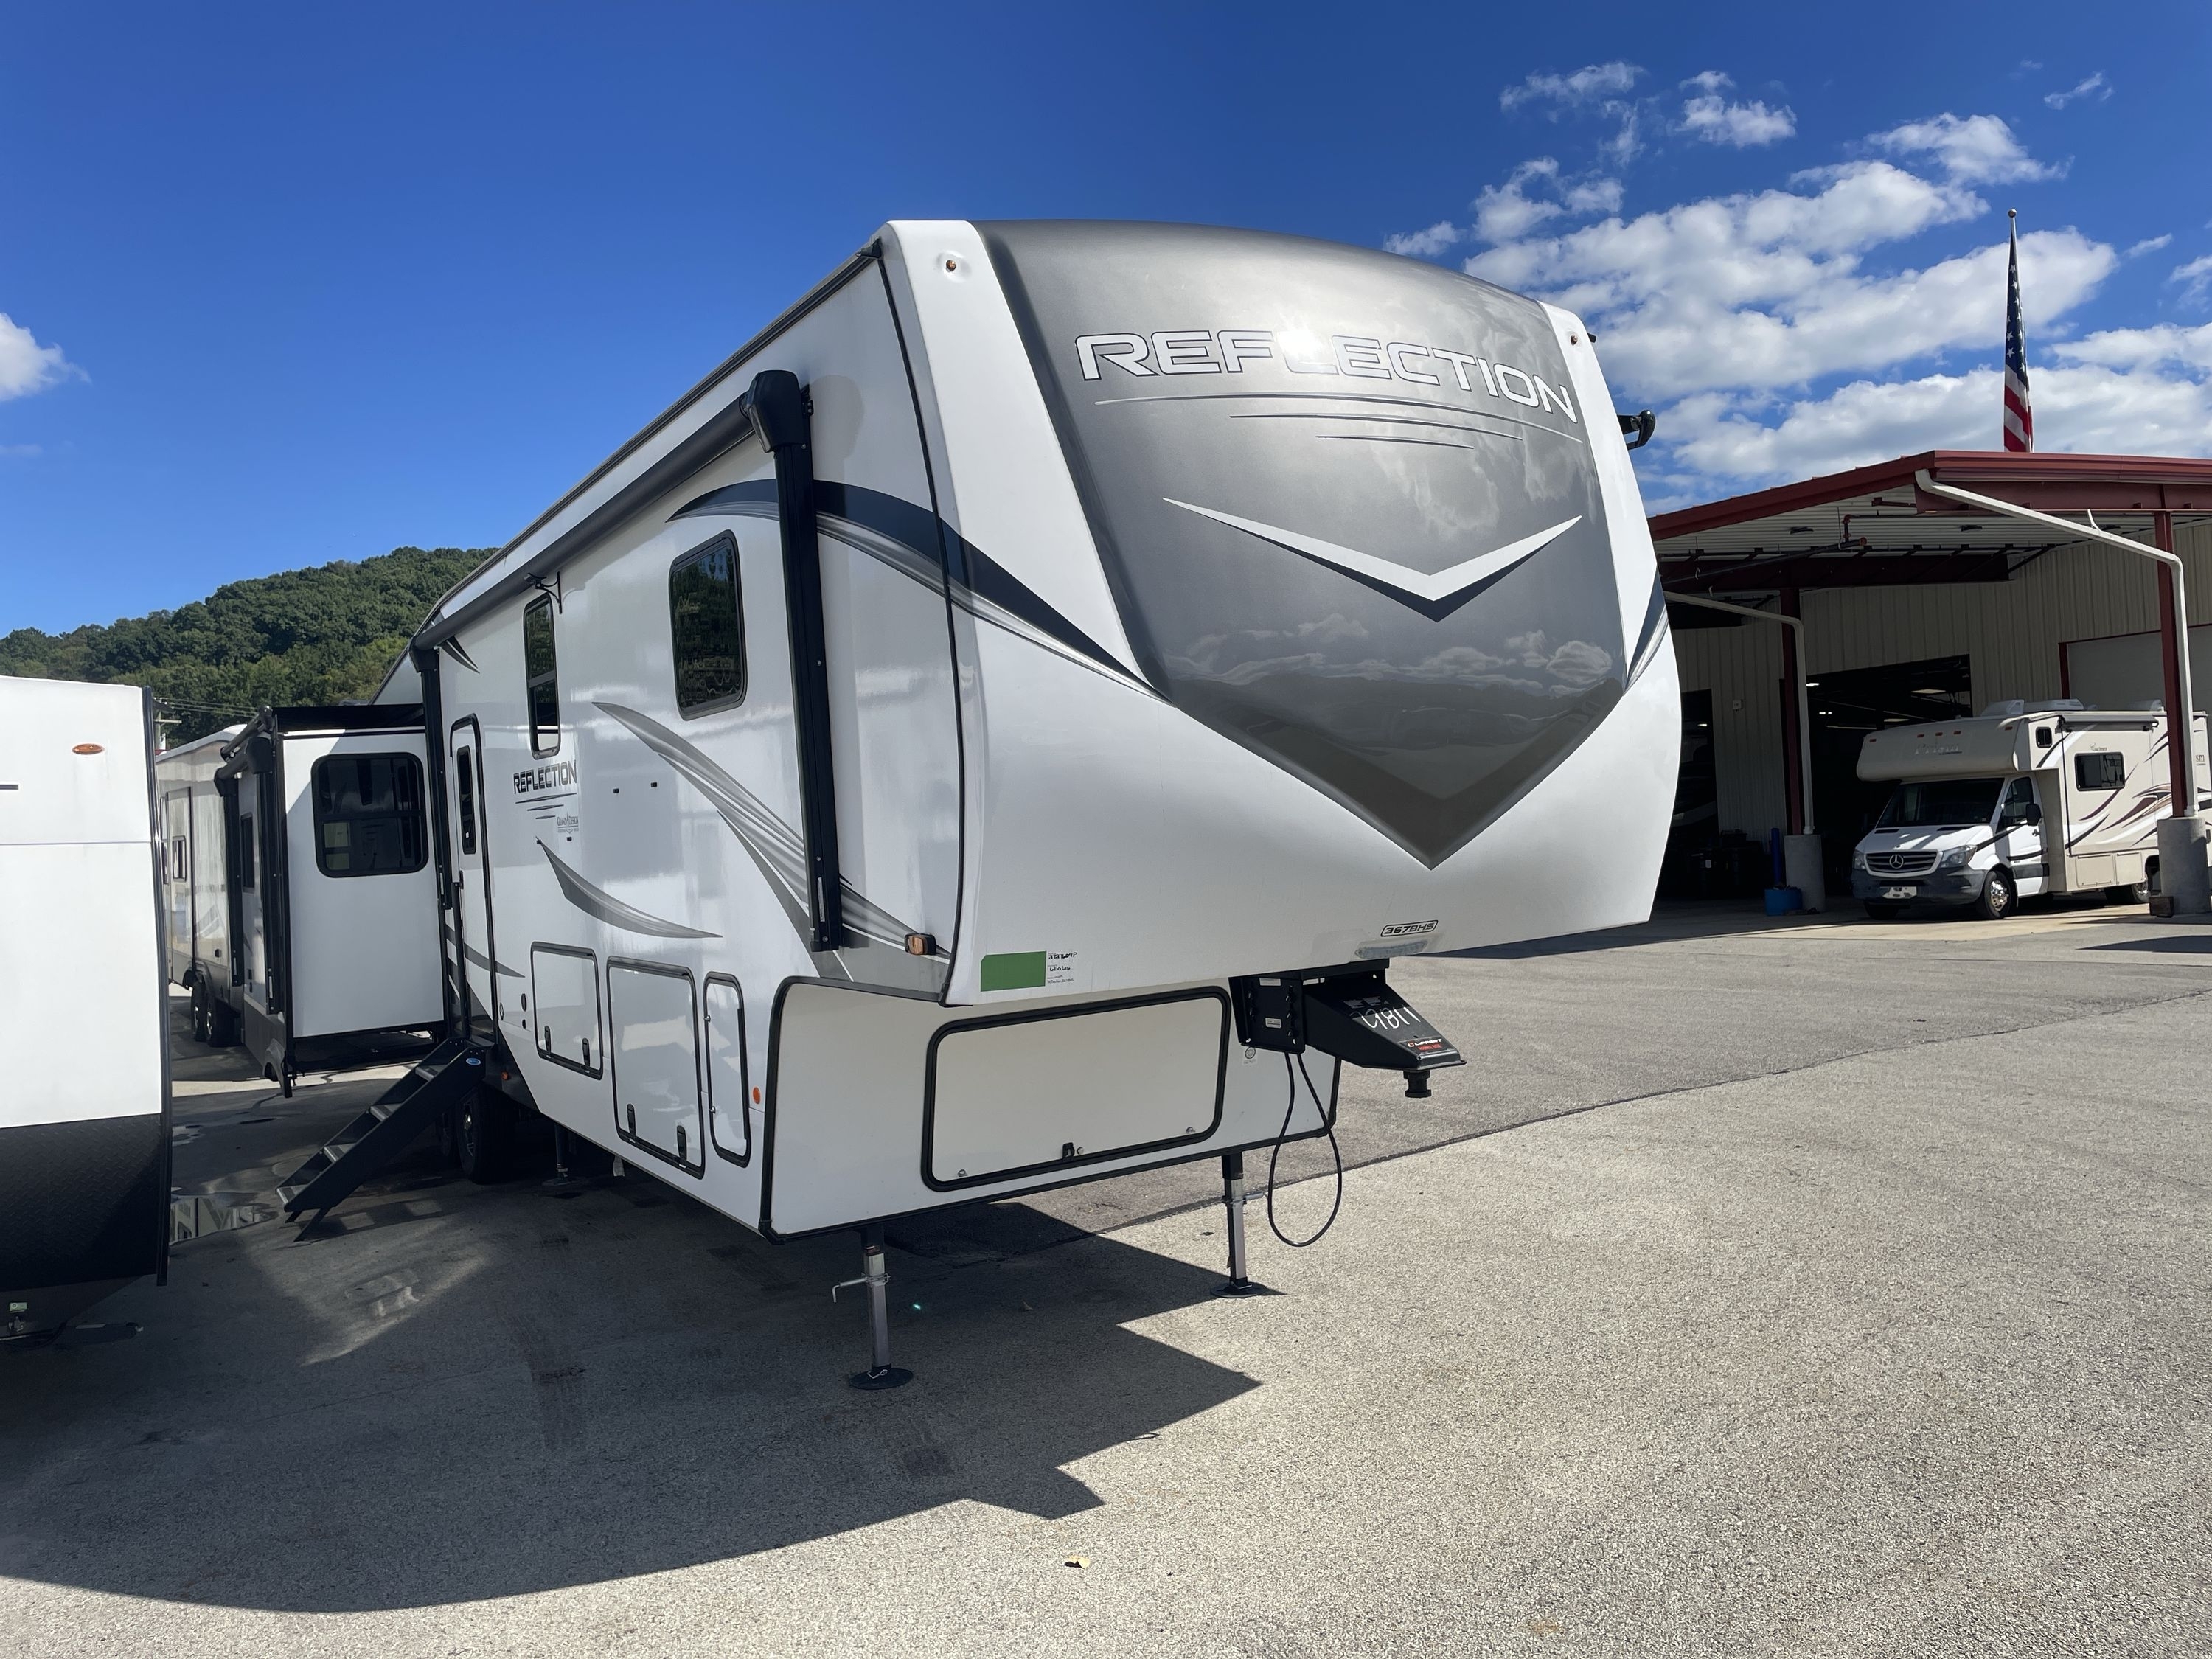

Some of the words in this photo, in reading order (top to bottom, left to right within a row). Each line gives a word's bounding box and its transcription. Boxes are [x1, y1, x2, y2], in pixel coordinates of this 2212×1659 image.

[1075, 330, 1579, 424] REFLECTION
[513, 759, 577, 794] REFLECTION
[1383, 922, 1435, 934] 367BHS
